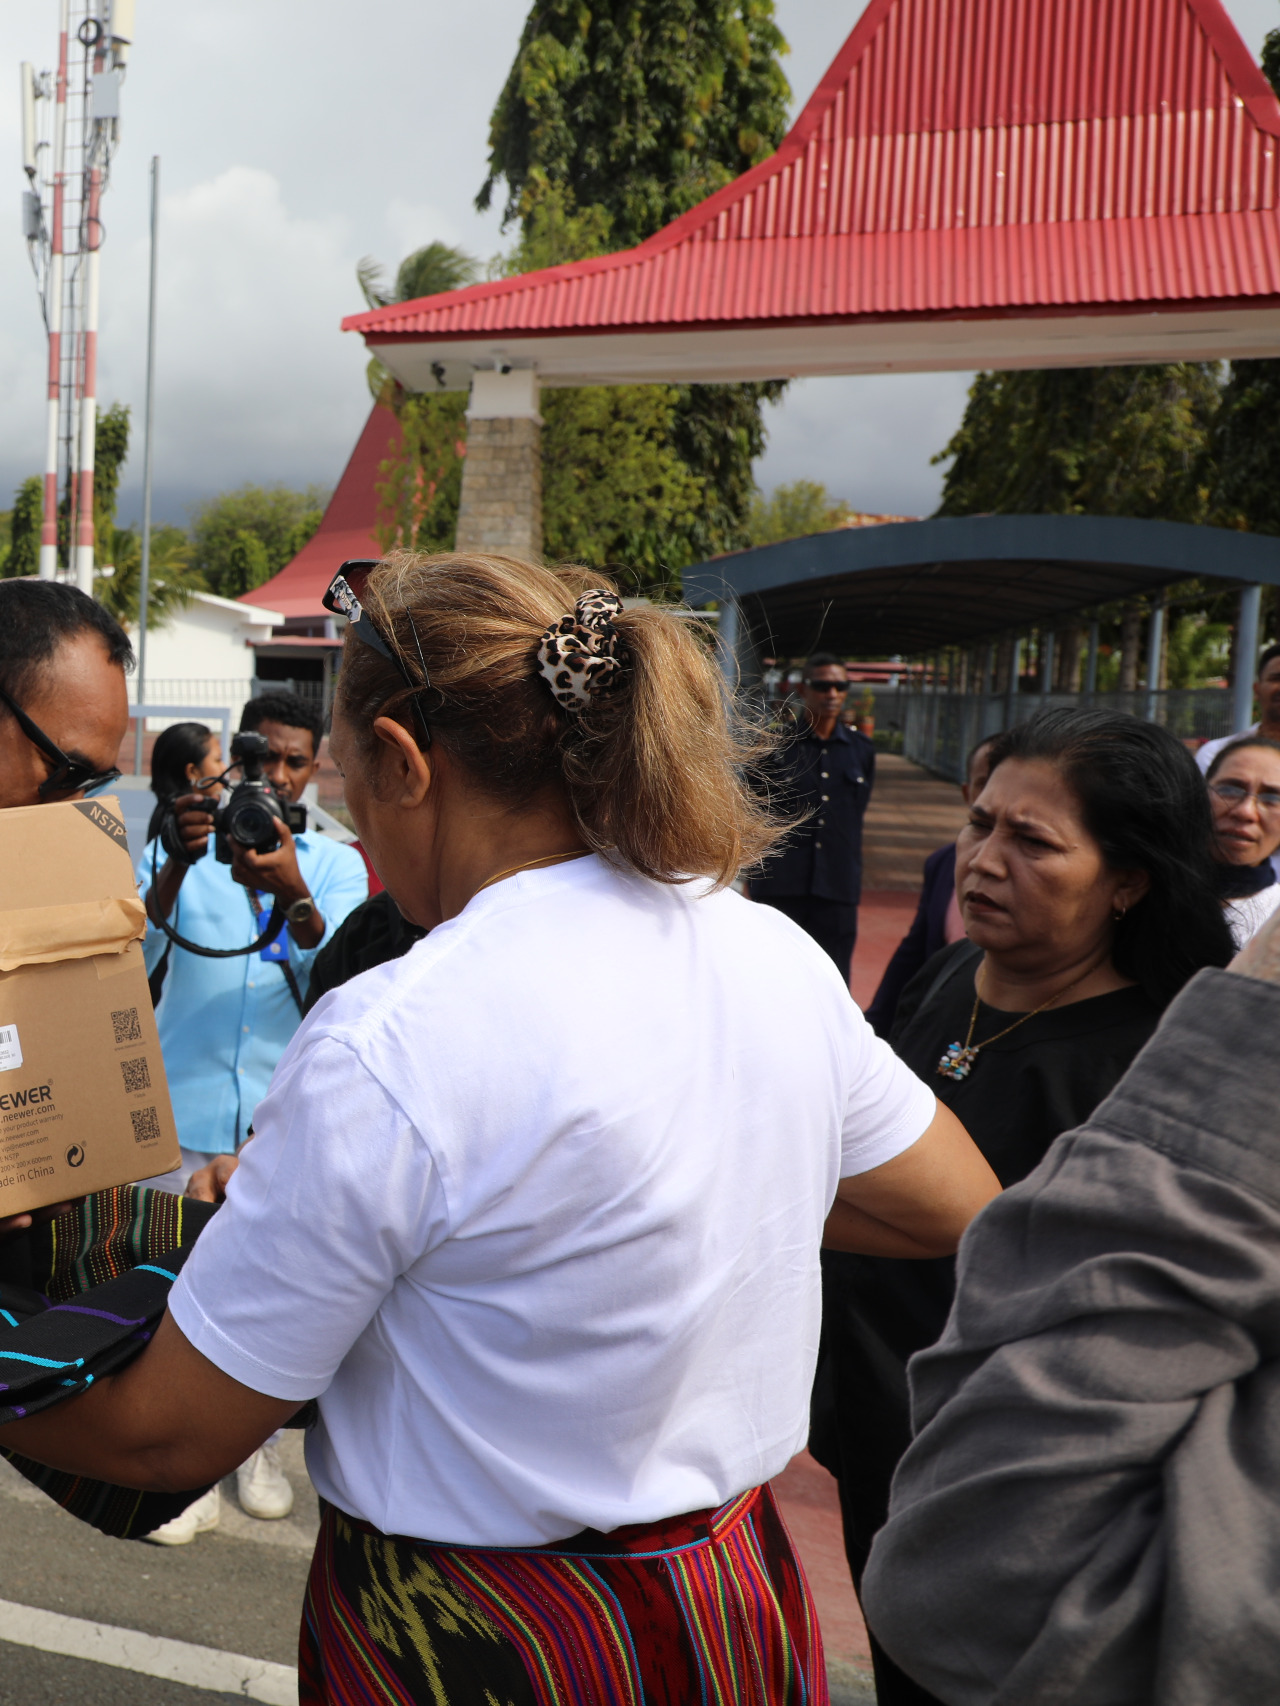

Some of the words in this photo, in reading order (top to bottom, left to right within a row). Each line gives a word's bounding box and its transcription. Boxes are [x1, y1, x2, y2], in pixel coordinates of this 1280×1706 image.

[90, 805, 125, 836] NS7P
[3, 1124, 16, 1135] your
[16, 1119, 39, 1131] product
[39, 1113, 64, 1124] warranty
[1, 1136, 49, 1152] vip@neewer.com
[4, 1152, 20, 1162] NS7P
[16, 1172, 26, 1183] in
[27, 1166, 55, 1180] China
